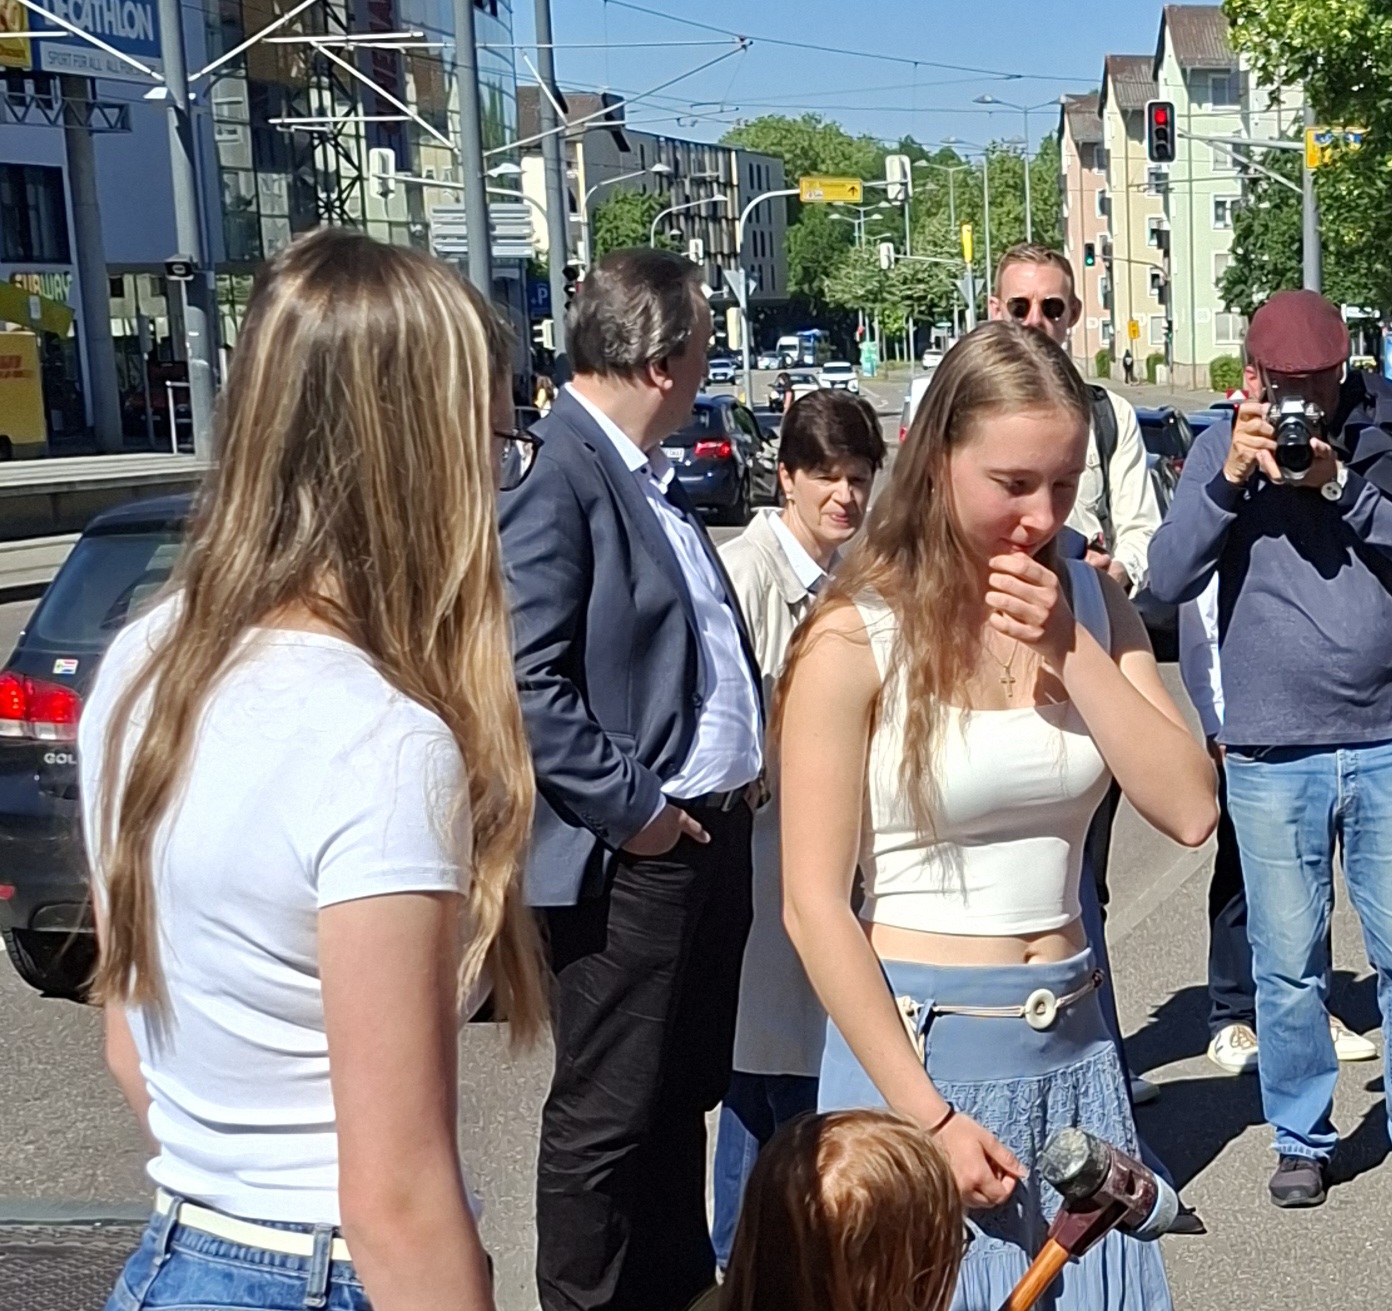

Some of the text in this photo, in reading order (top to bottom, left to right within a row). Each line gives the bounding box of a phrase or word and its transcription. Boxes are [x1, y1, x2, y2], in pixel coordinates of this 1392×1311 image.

[48, 51, 71, 66] SPORT
[73, 54, 88, 68] FOR
[89, 56, 102, 71] ALL
[44, 752, 77, 764] GOL
